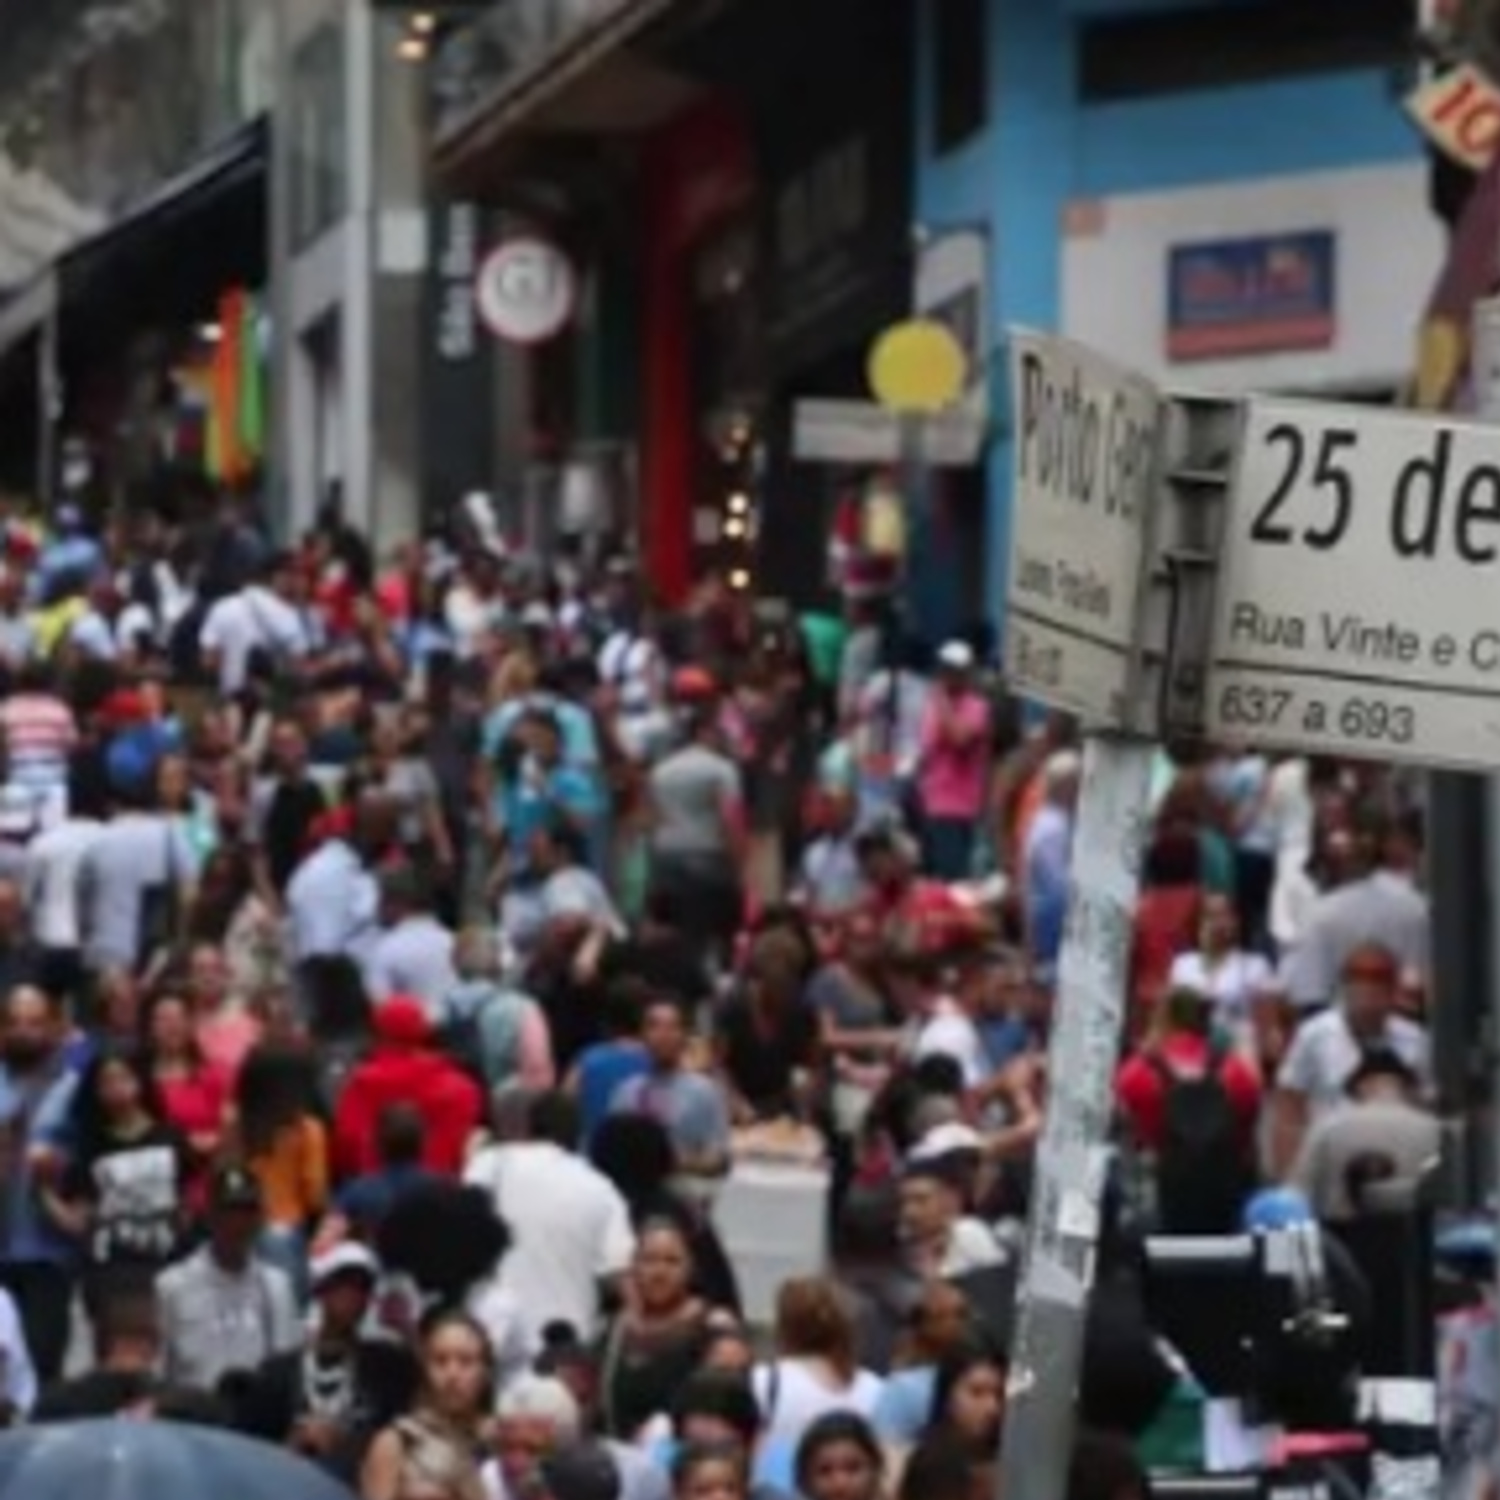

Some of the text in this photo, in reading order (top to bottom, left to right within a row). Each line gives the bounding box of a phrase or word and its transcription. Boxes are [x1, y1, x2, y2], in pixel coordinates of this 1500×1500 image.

[1249, 422, 1358, 551] 25
[1229, 601, 1305, 652] Rua
[1320, 610, 1421, 662] Vinte
[1430, 635, 1457, 664] e
[1219, 686, 1415, 744] 637 a 693
